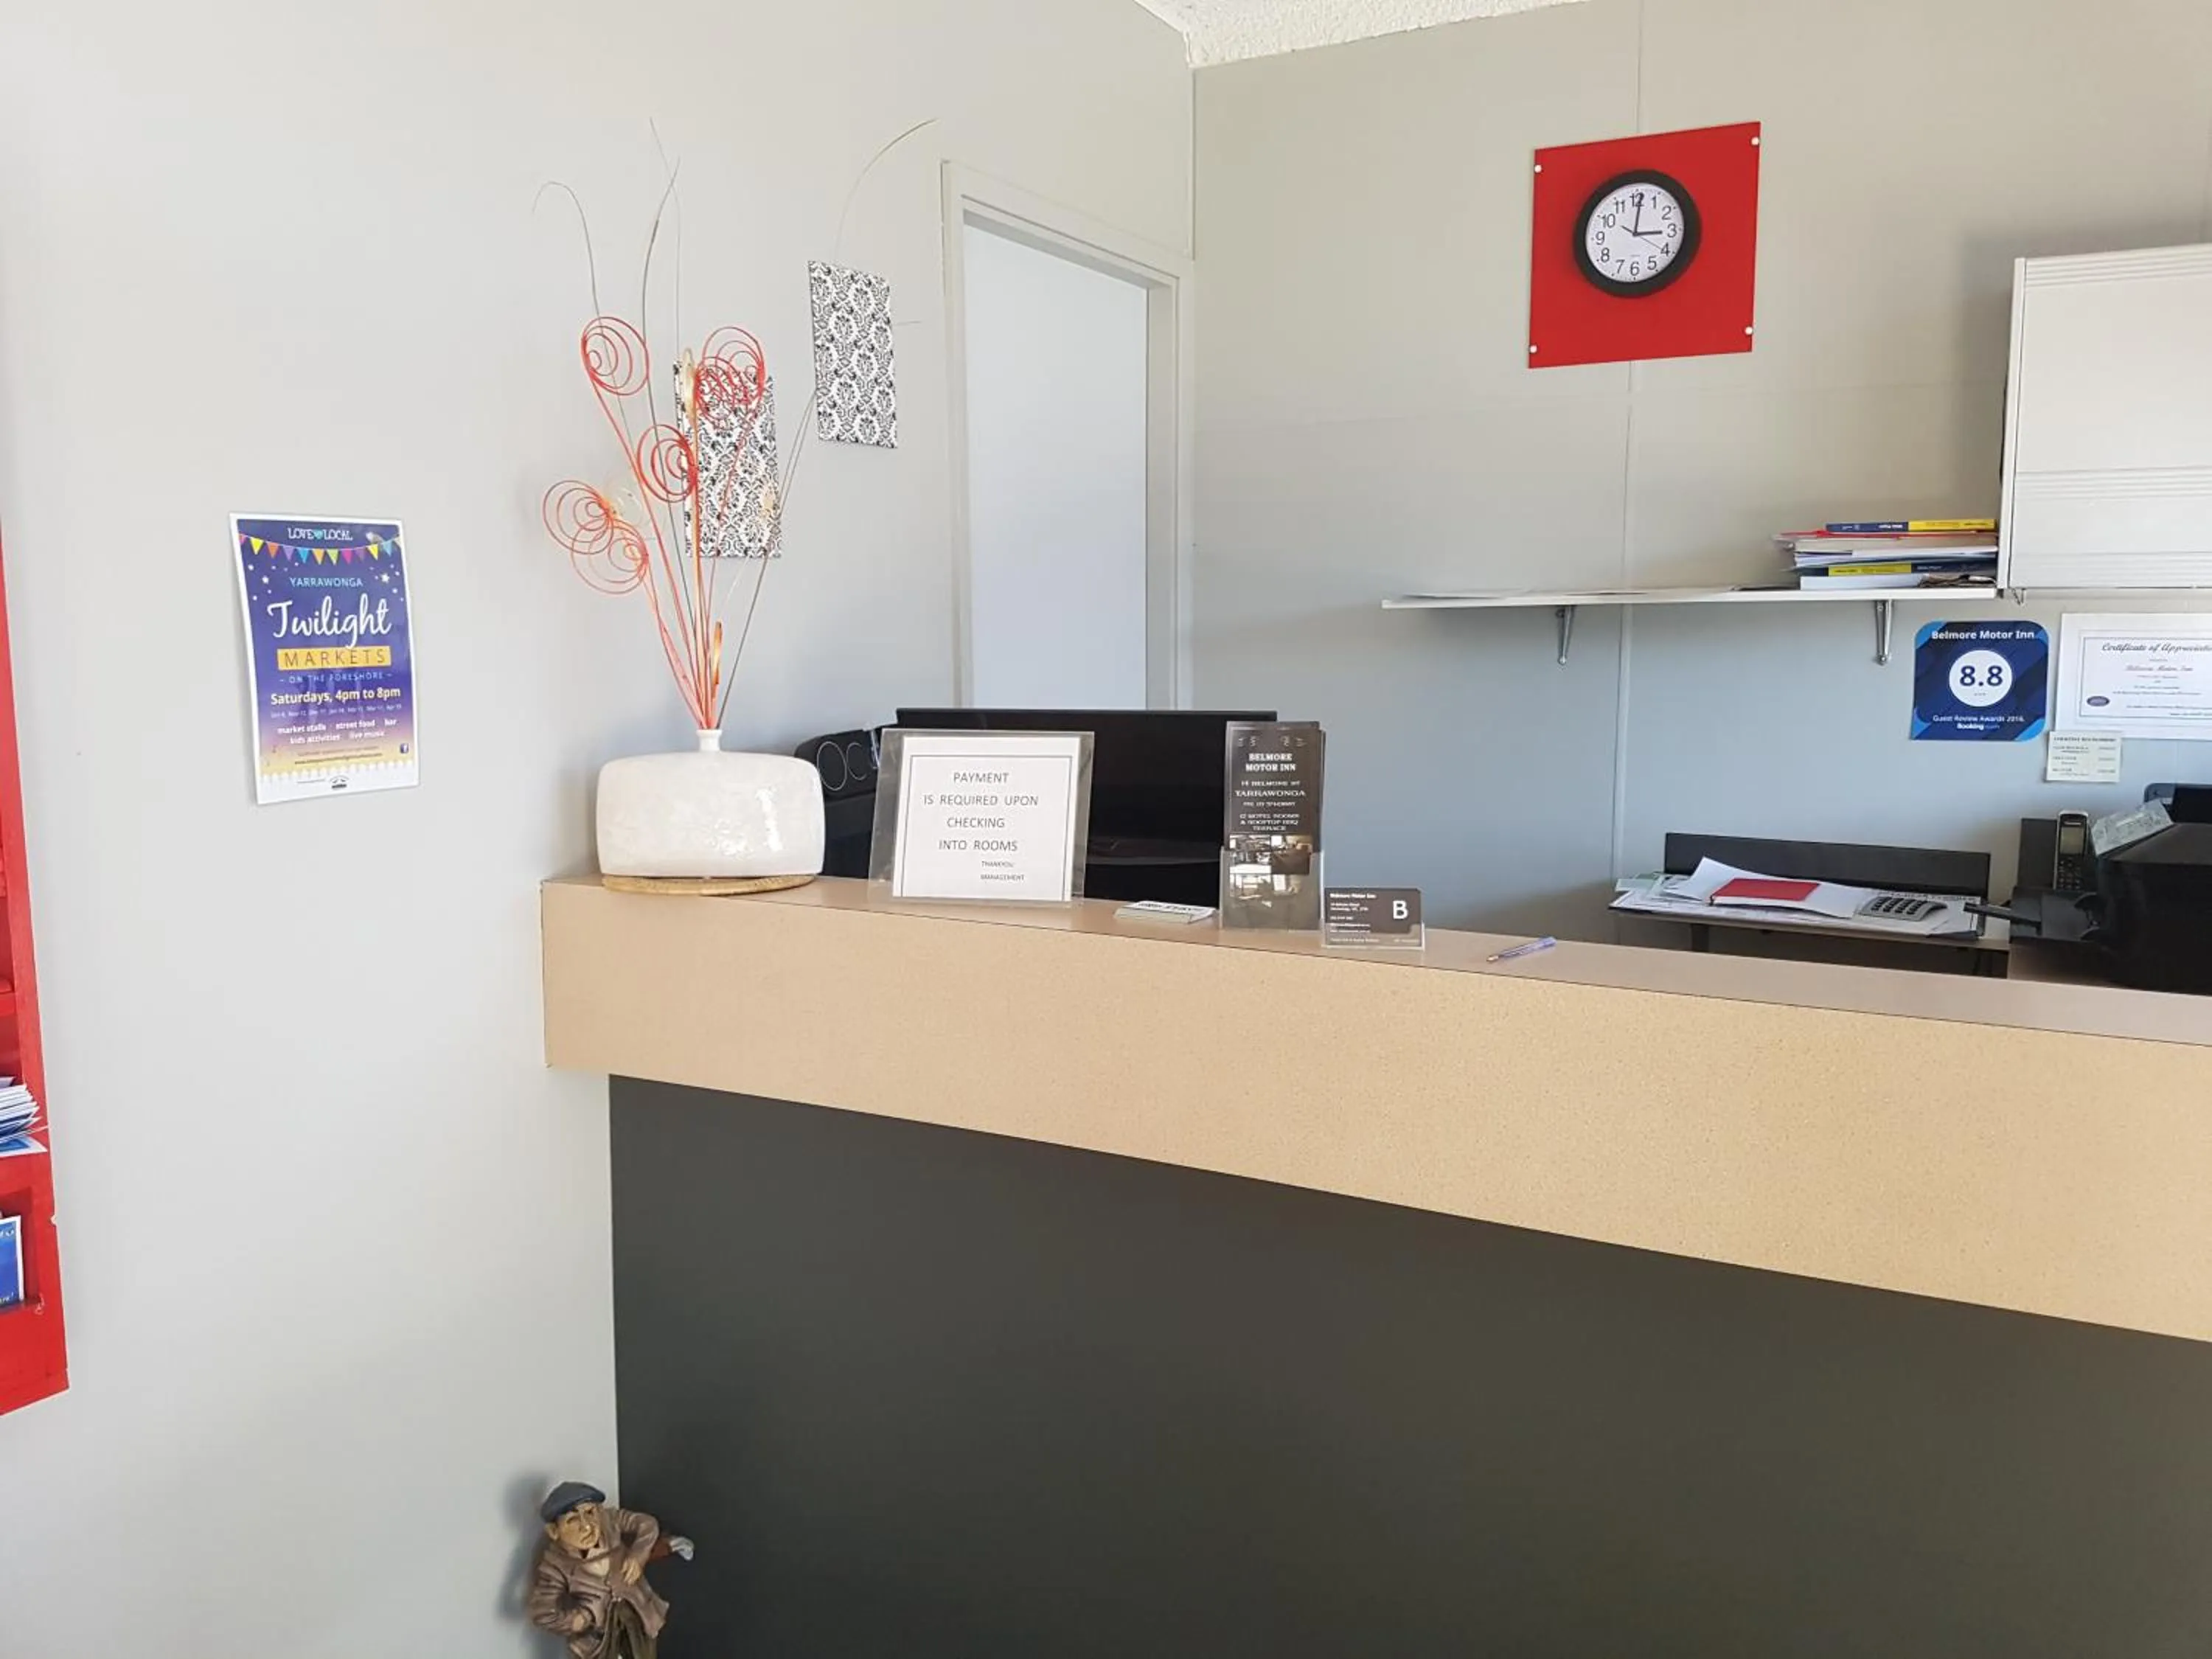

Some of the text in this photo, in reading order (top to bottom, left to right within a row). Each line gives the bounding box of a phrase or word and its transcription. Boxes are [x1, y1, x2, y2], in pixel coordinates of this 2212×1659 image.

[1630, 192, 1644, 206] 12
[1615, 200, 1626, 214] 11
[1662, 205, 1672, 220] 2
[1601, 213, 1615, 229] 10
[1667, 223, 1677, 238] 3
[1596, 231, 1605, 246] 9
[1601, 247, 1610, 262] 8
[1660, 243, 1670, 257] 4
[1615, 260, 1625, 274] 7
[1630, 261, 1640, 276] 6
[1647, 256, 1657, 270] 5
[287, 527, 353, 541] LOVE LOCAL
[290, 577, 364, 588] YARRAWONGA
[267, 593, 392, 649] Twilight
[1932, 630, 2035, 640] Belmore Motor Inn
[2101, 642, 2146, 653] Certificate
[284, 648, 386, 669] MARKETS
[288, 671, 383, 684] ON THE FORESHORE
[1959, 665, 2003, 688] 8.8
[271, 686, 401, 706] Saturdays, 4pm to 8pm
[1933, 714, 1953, 723] Guest
[277, 718, 397, 734] market stalls street food bar
[1248, 753, 1293, 762] BELMORE
[1245, 763, 1296, 772] MOTOR INN
[953, 772, 1009, 784] PAYMENT
[923, 794, 1038, 807] IS REQUIRED UPON
[946, 816, 1005, 829] CHECKING
[938, 839, 1018, 852] INTO ROOMS
[1393, 900, 1408, 919] B
